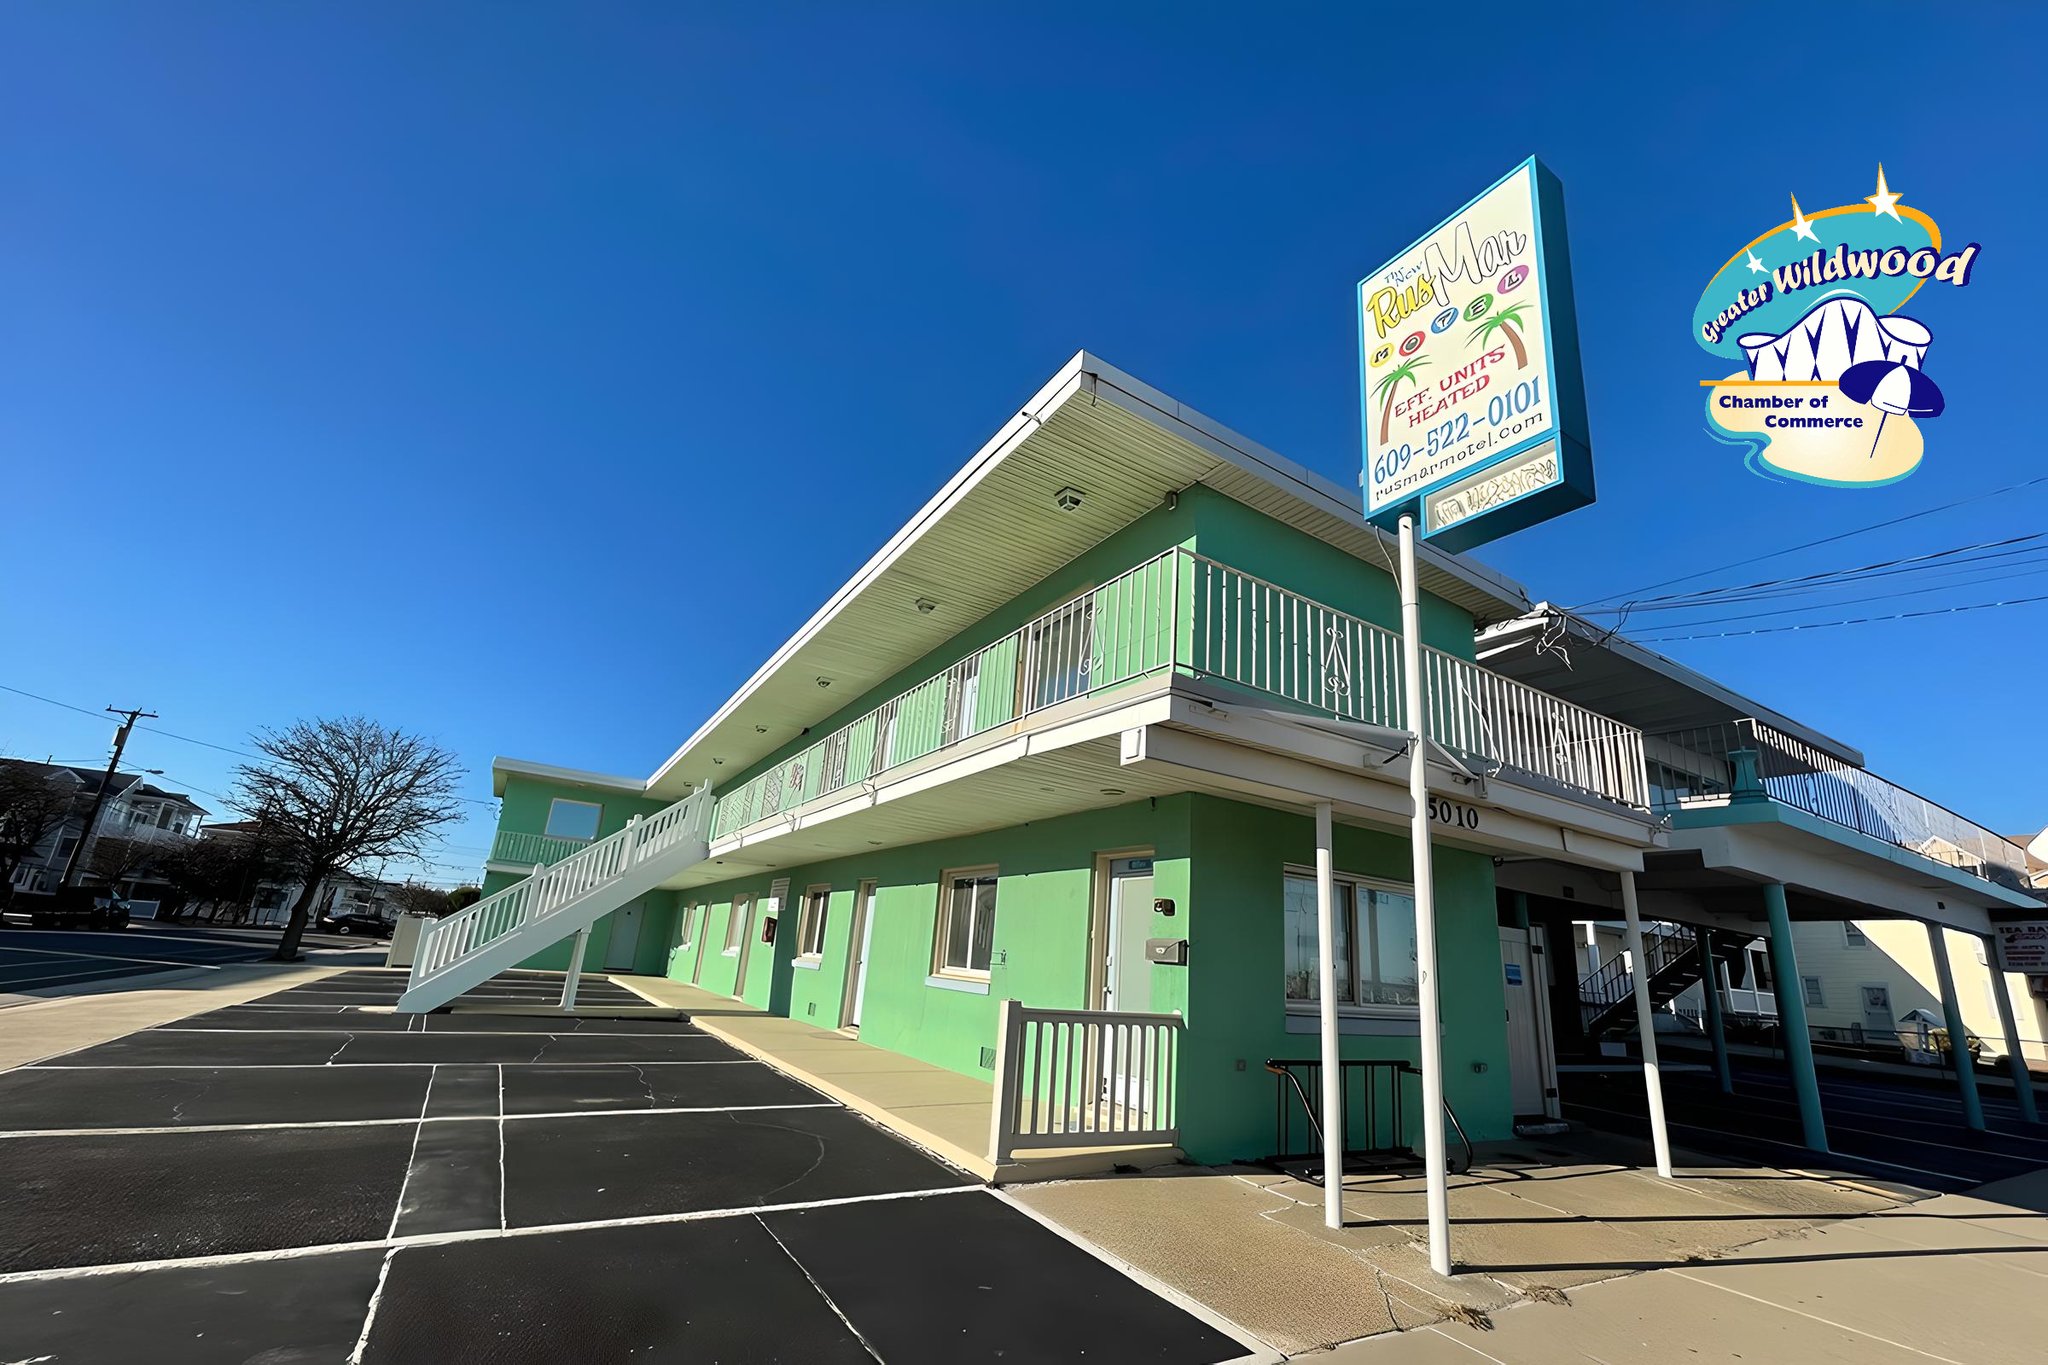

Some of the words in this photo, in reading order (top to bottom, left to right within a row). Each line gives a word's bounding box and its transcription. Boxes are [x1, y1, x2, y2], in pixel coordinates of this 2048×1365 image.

[1373, 273, 1522, 364] MOTEL
[1394, 387, 1433, 418] EFF.
[1439, 344, 1506, 392] UNITS
[1408, 374, 1490, 429] HEATED
[1374, 375, 1541, 485] 609-522-0101
[1375, 412, 1544, 501] rusmarmotel.com
[1428, 797, 1479, 830] 5010
